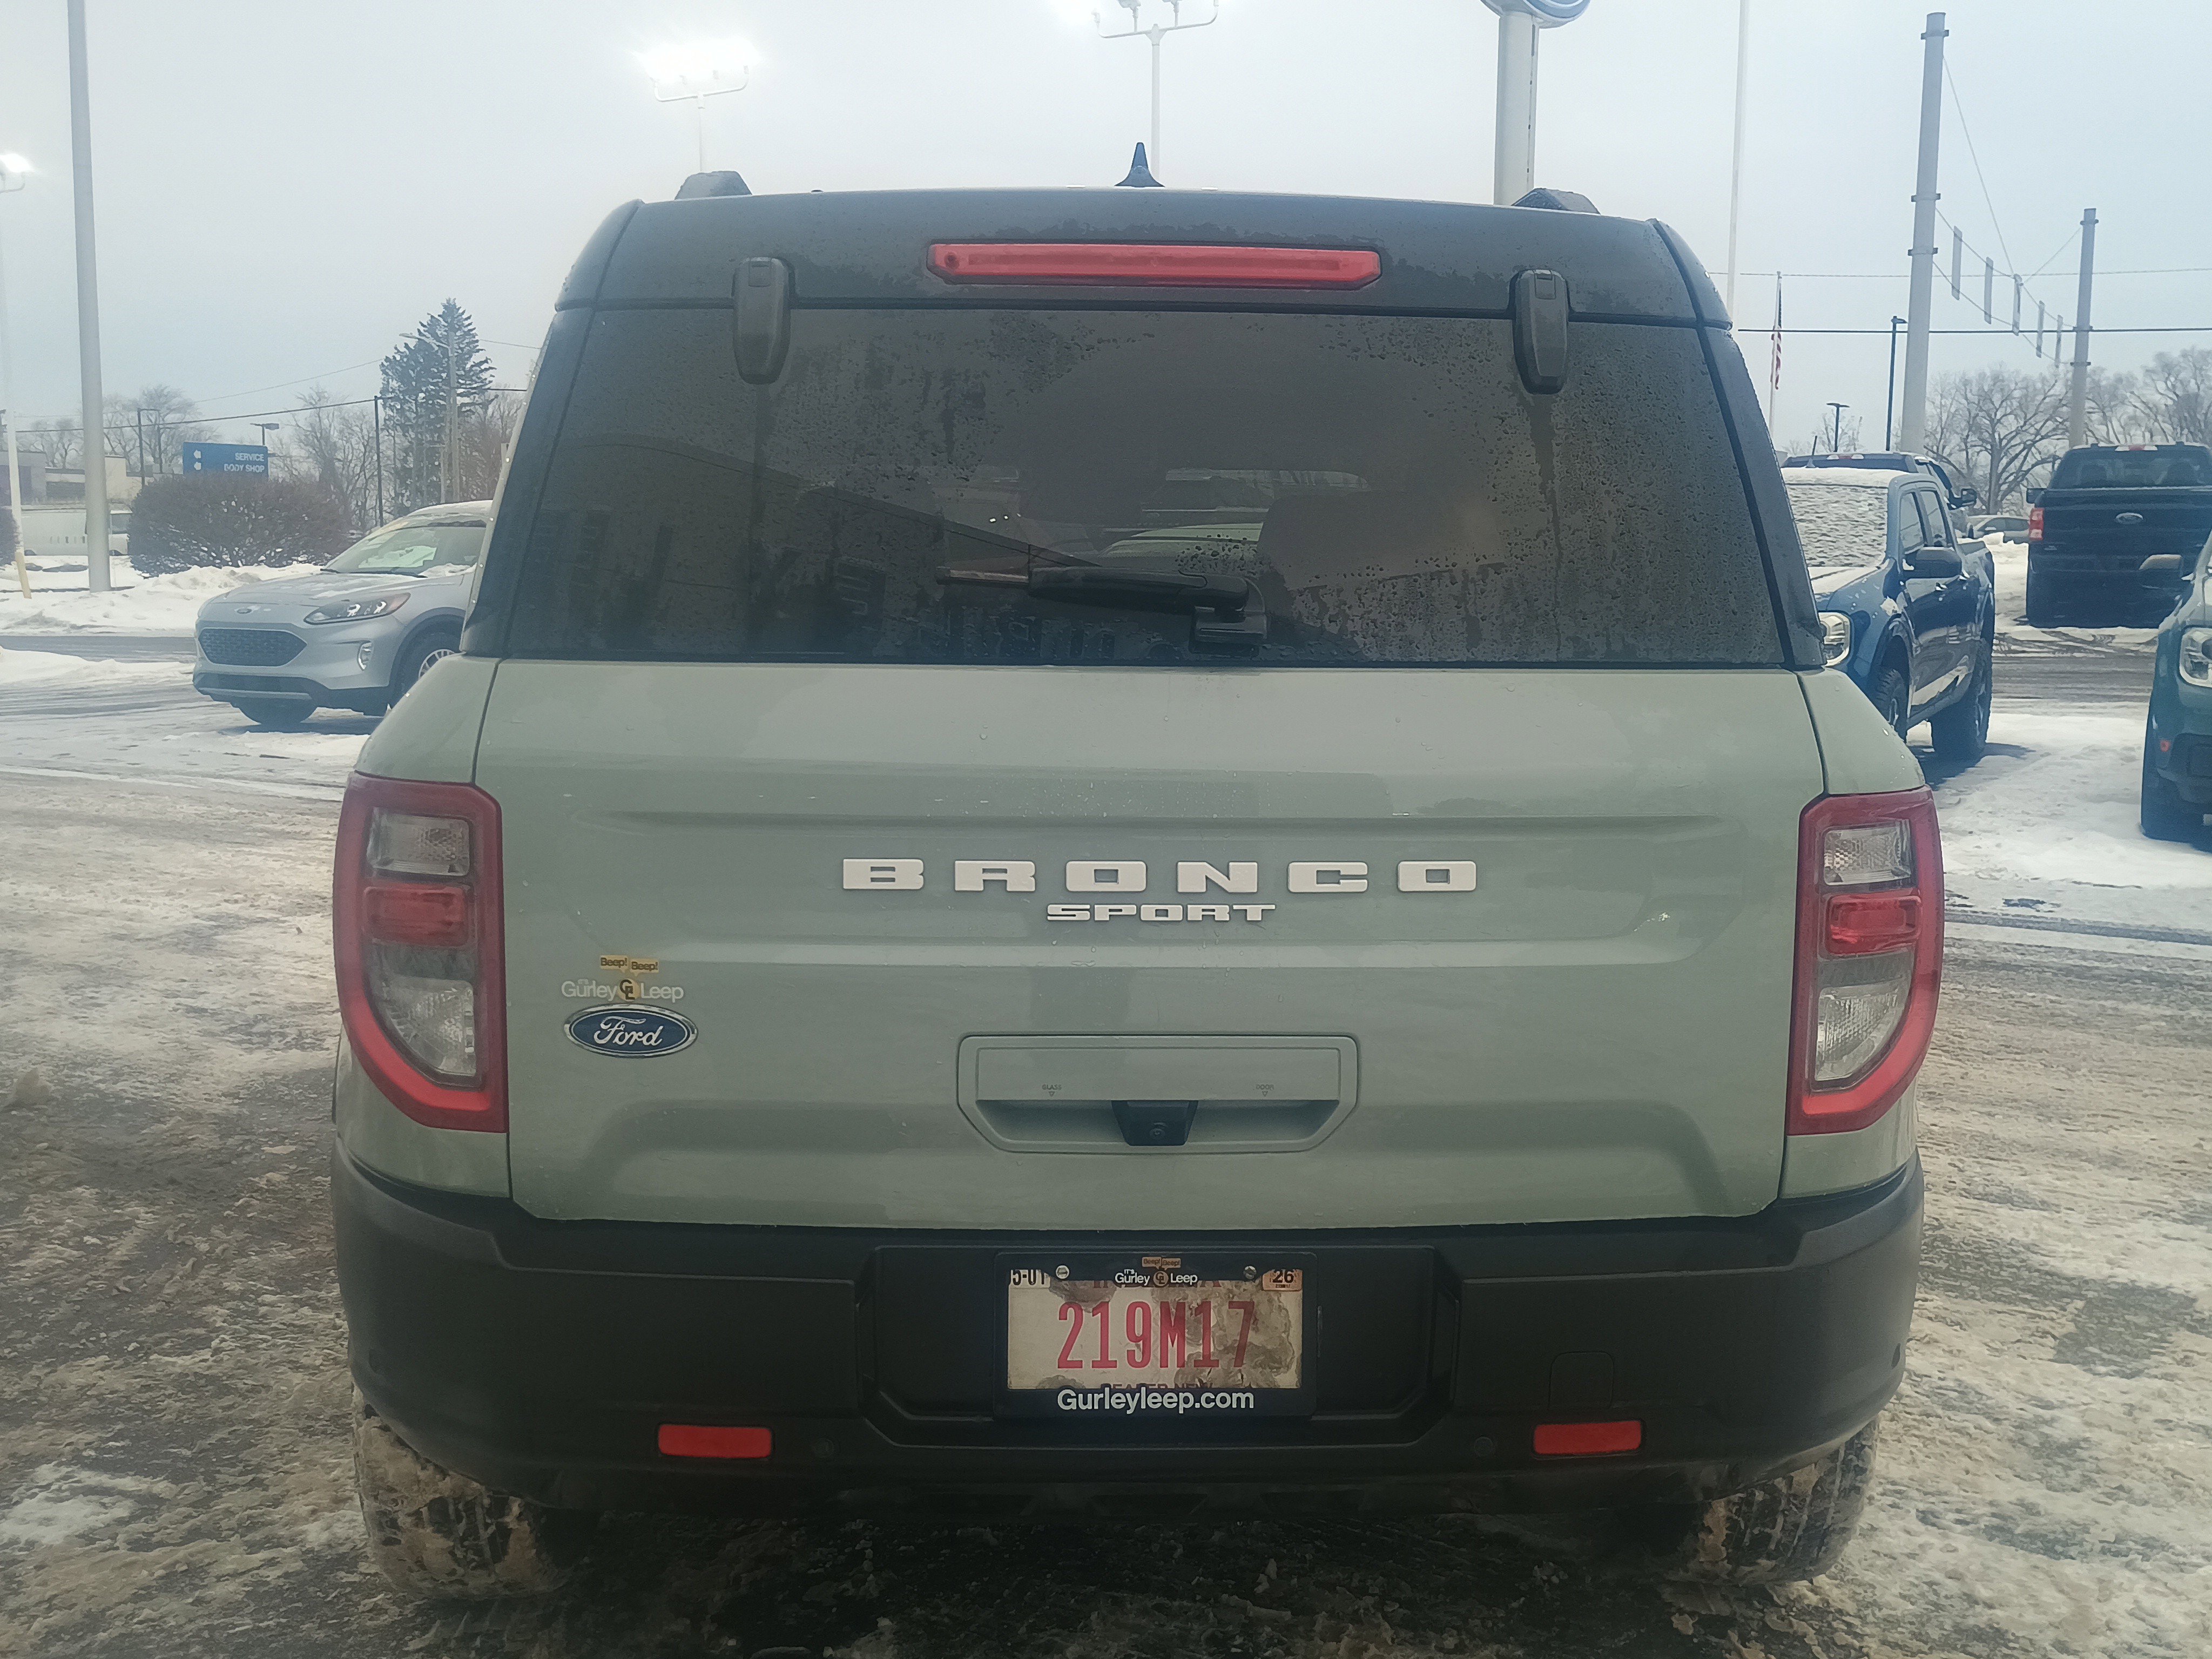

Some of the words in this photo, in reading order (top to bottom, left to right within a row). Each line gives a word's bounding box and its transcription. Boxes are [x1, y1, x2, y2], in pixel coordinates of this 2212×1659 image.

[235, 453, 265, 461] SERVICE
[246, 464, 265, 473] SHOP
[842, 859, 1476, 892] BRONCO
[1047, 904, 1276, 921] SPORT
[601, 957, 628, 968] Beep!
[631, 961, 658, 971] Beep!
[561, 980, 617, 1001] Gurley
[641, 982, 684, 1003] Leep
[594, 1016, 664, 1046] Ford
[1115, 1272, 1150, 1286] Gurley
[1170, 1272, 1198, 1285] Leep
[1057, 1300, 1255, 1369] 219M17
[1057, 1386, 1255, 1414] Gurleyleep.com
